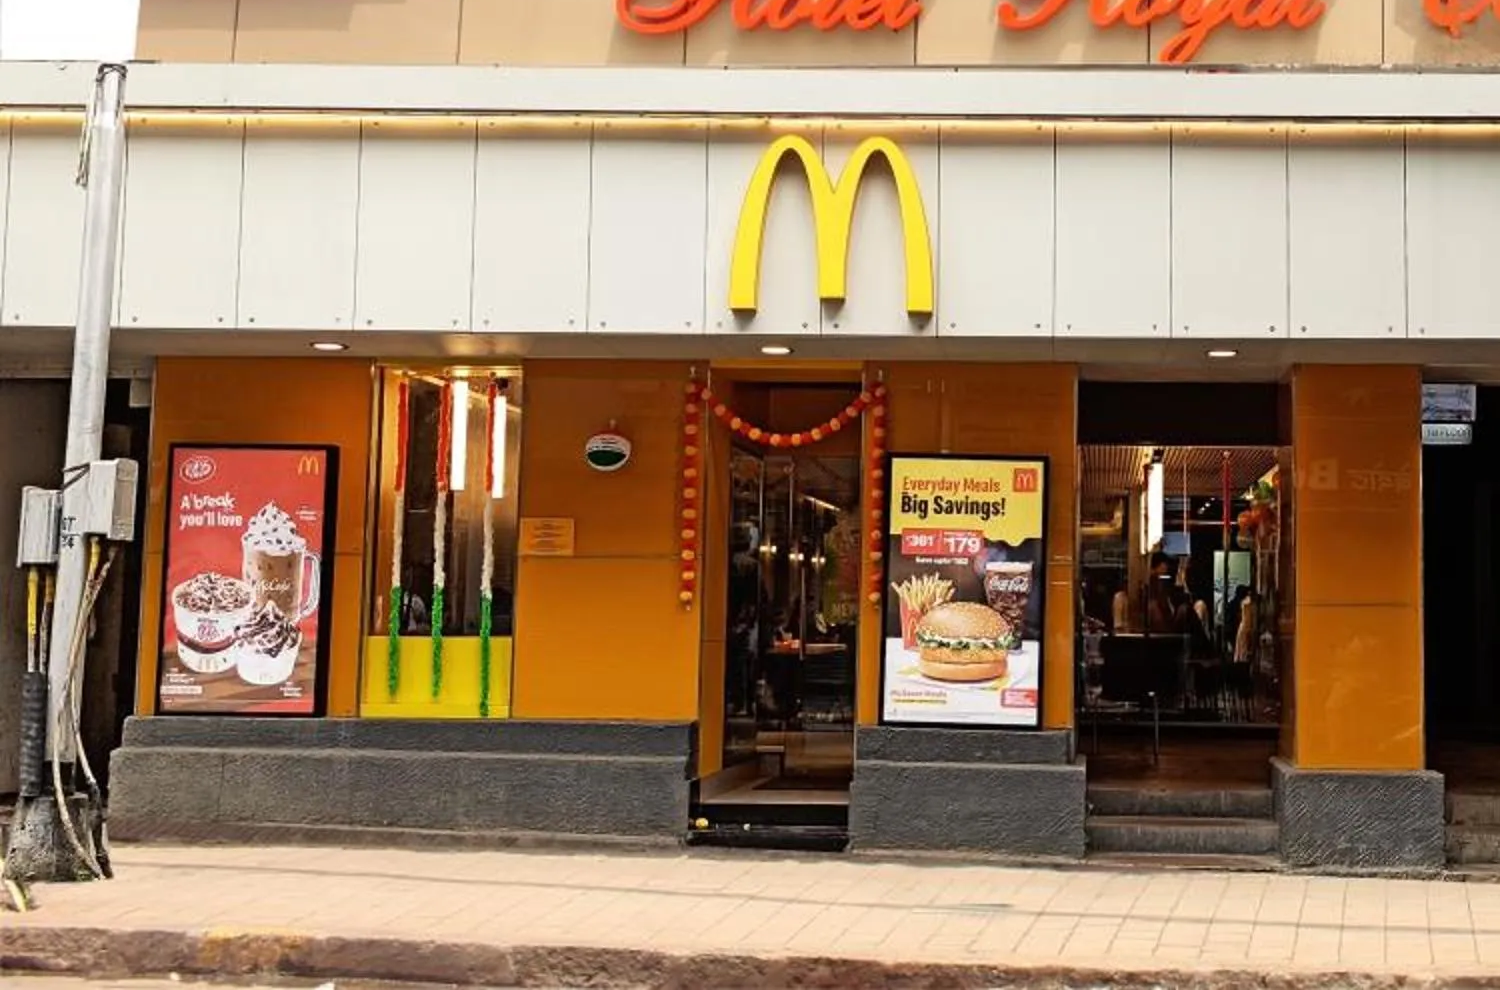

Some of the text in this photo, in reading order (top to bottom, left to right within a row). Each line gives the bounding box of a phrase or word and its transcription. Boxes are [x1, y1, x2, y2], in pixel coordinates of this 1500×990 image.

[903, 476, 1000, 495] Everyday Meals
[194, 492, 235, 510] break
[901, 494, 1005, 520] Big Savings!
[180, 511, 243, 531] you'll love
